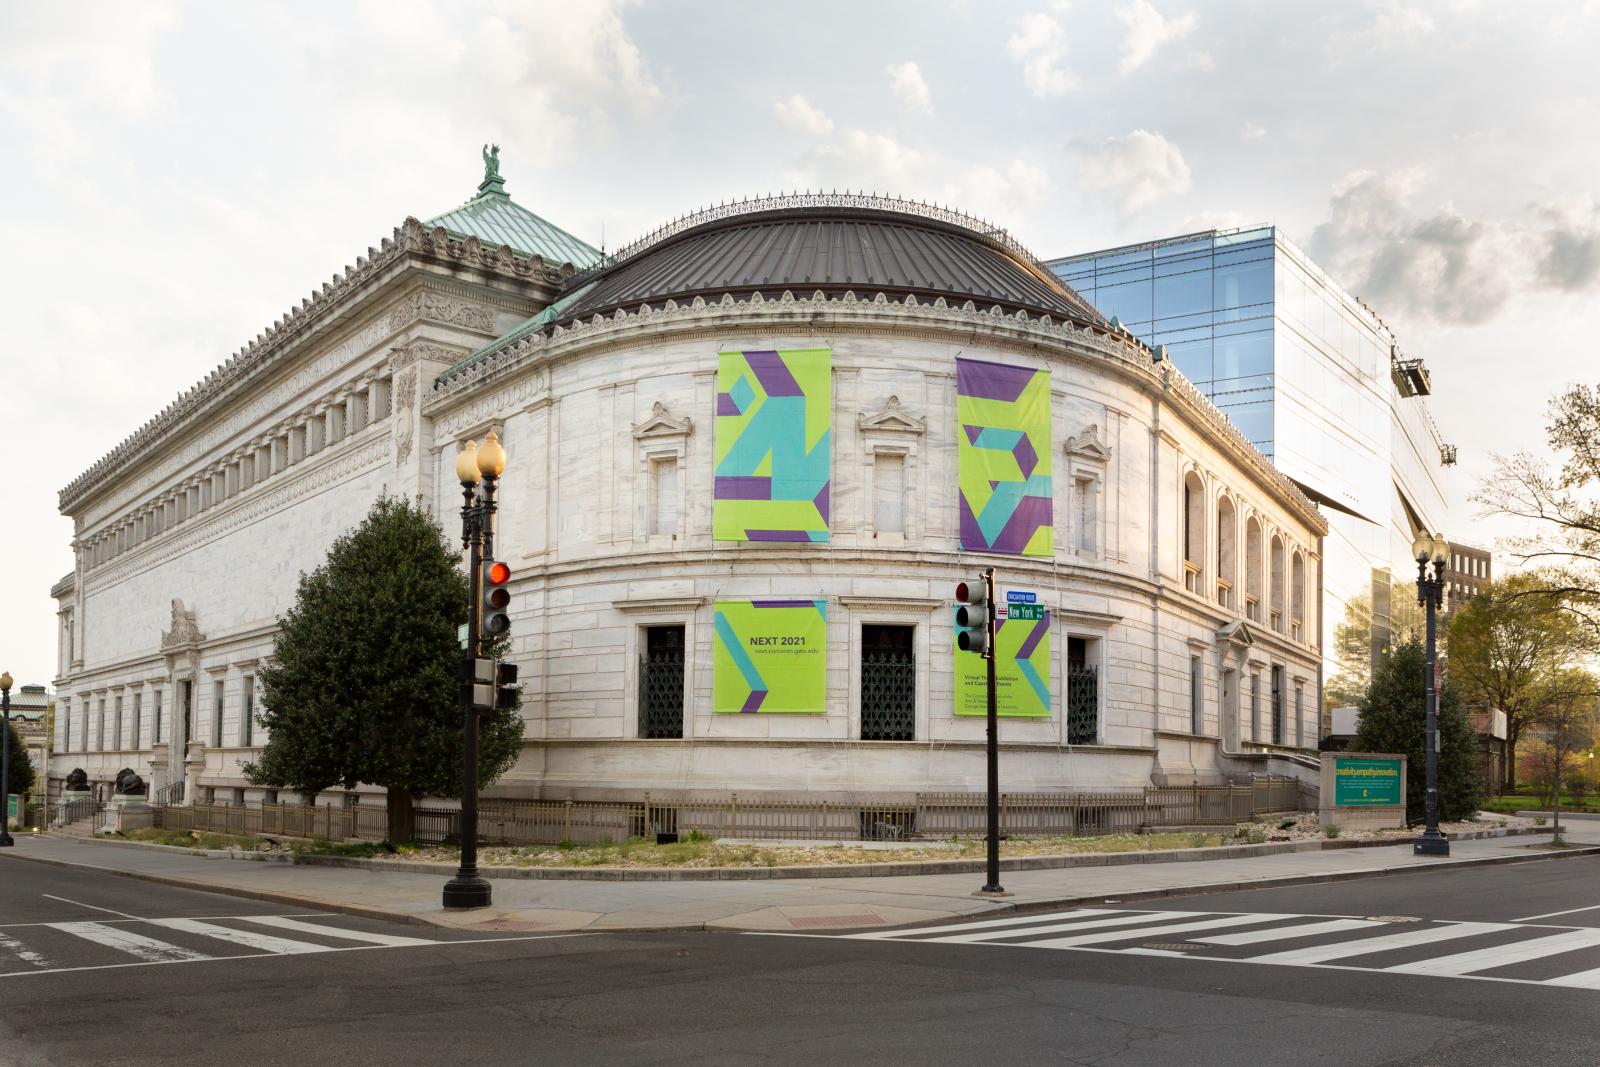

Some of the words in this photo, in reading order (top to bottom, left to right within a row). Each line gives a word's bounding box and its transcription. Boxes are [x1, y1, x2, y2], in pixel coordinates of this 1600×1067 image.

[313, 341, 354, 378] ALLSTON
[355, 317, 391, 354] INGRES
[1009, 606, 1020, 618] New
[1021, 606, 1034, 619] York
[750, 637, 778, 645] NEXT
[781, 637, 805, 645] 2021
